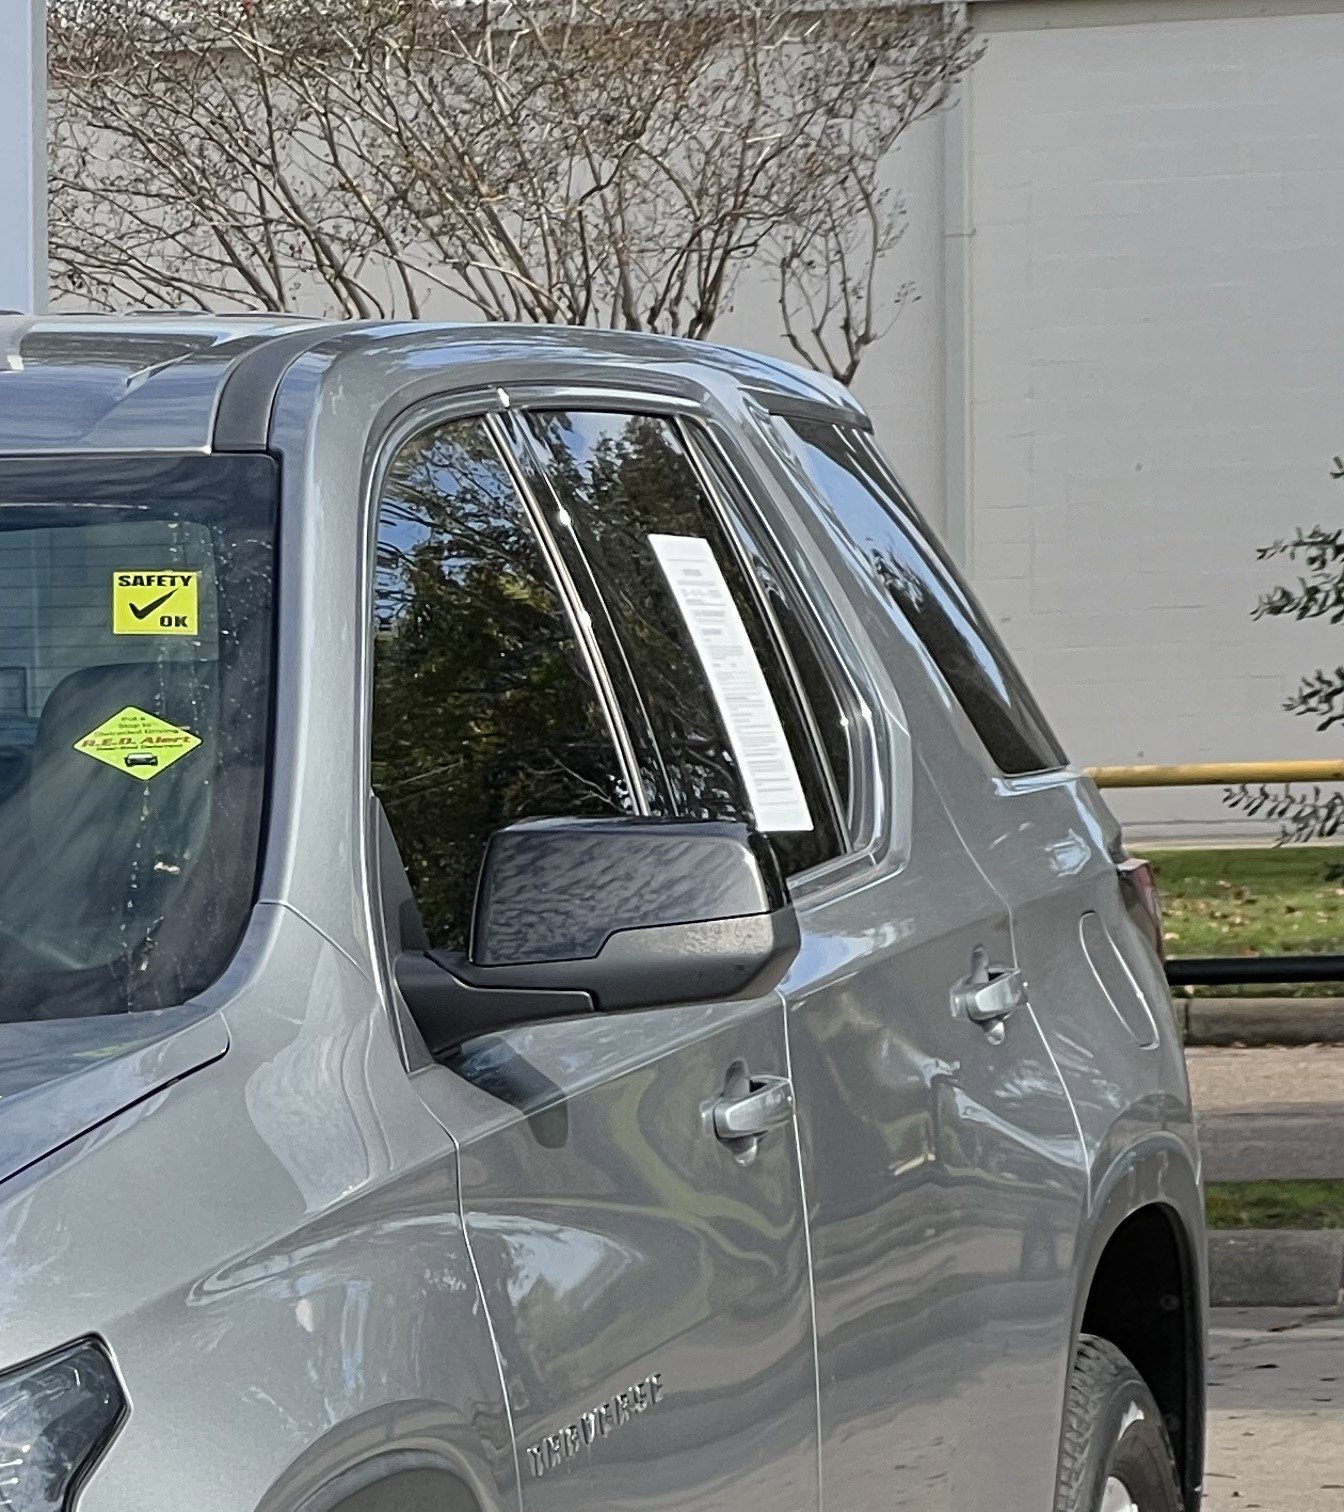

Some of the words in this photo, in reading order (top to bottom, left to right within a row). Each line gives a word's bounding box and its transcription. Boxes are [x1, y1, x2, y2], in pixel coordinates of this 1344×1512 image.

[118, 574, 192, 587] SAFETY
[159, 615, 188, 628] OK
[139, 736, 191, 745] Alert
